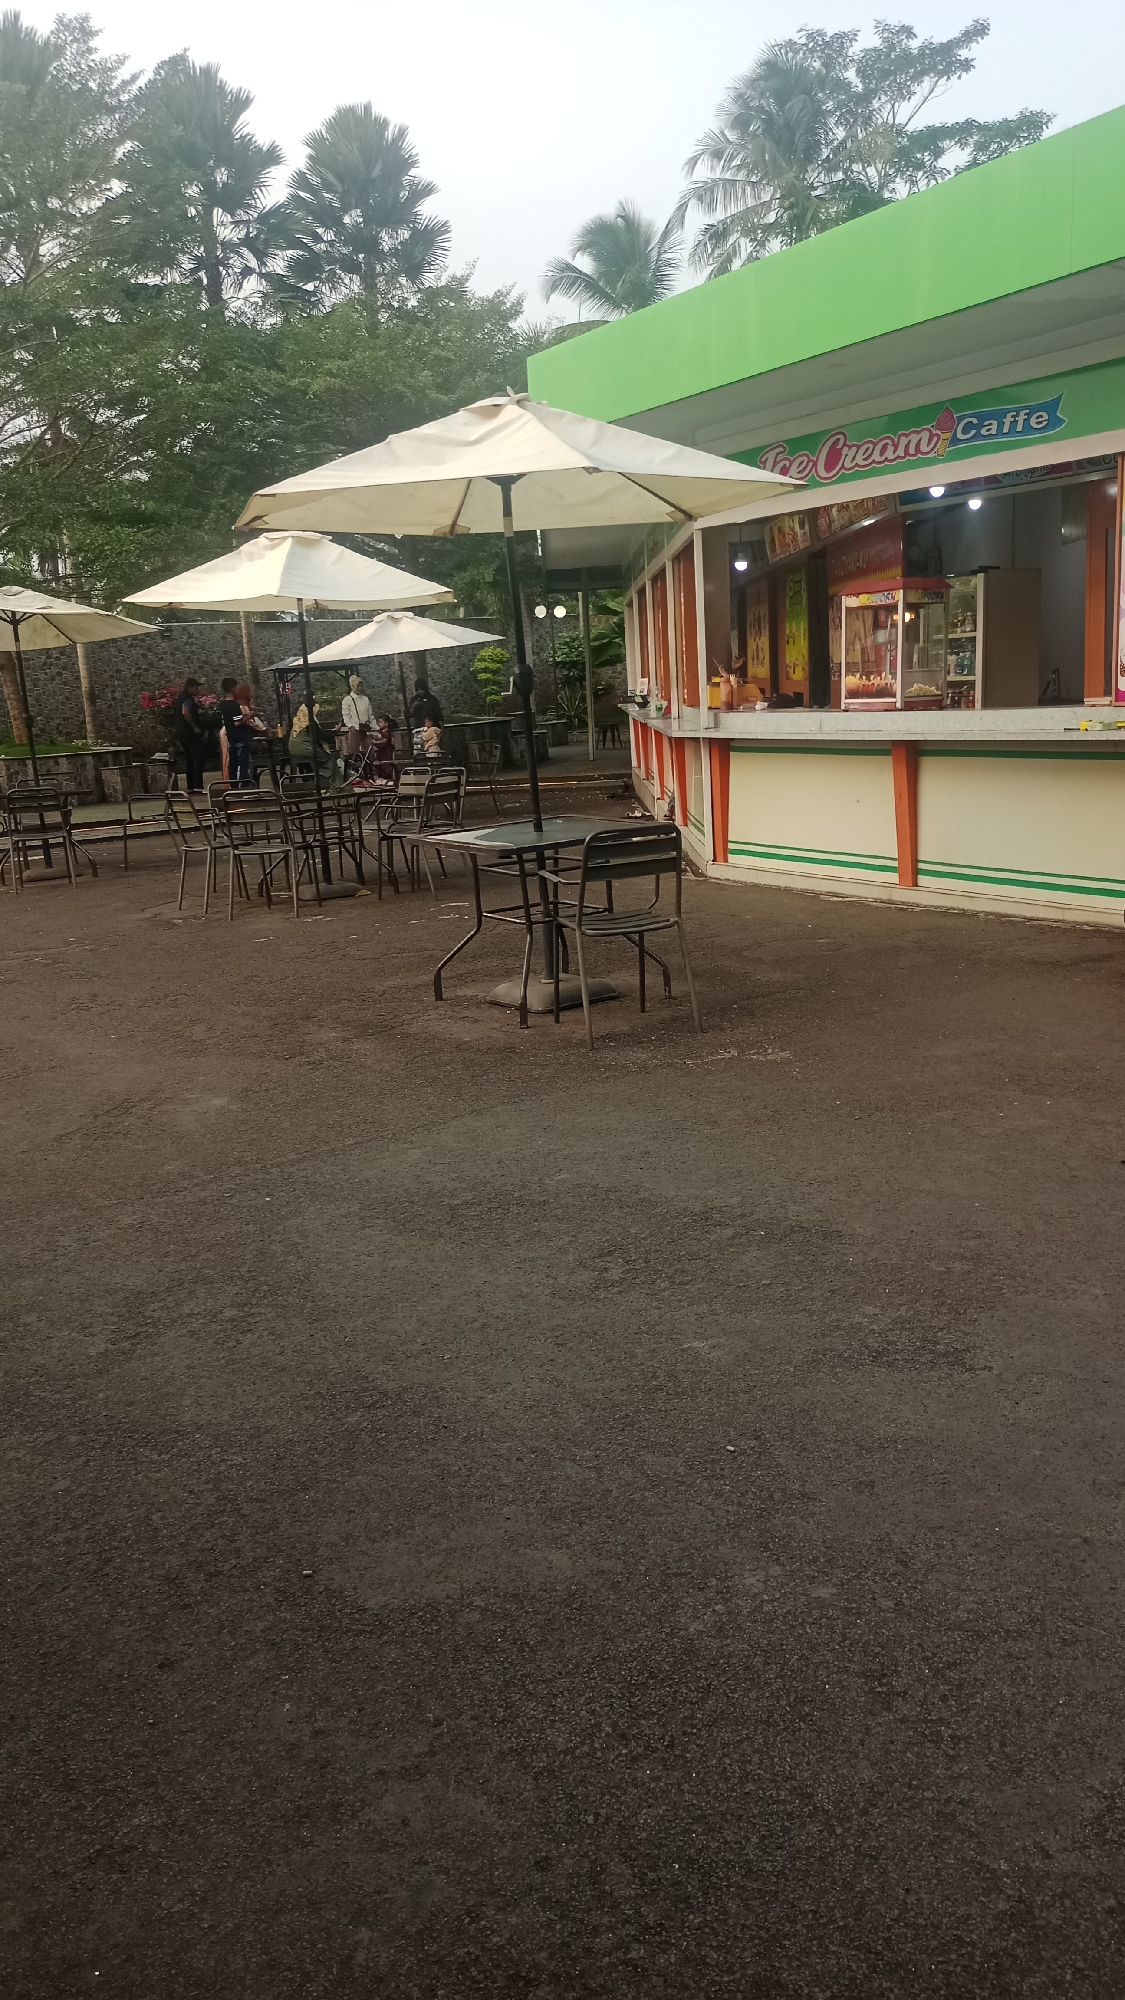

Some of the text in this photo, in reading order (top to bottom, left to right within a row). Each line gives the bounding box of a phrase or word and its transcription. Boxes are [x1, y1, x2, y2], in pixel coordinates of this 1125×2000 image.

[759, 409, 1050, 480] Ice Cream Caffe
